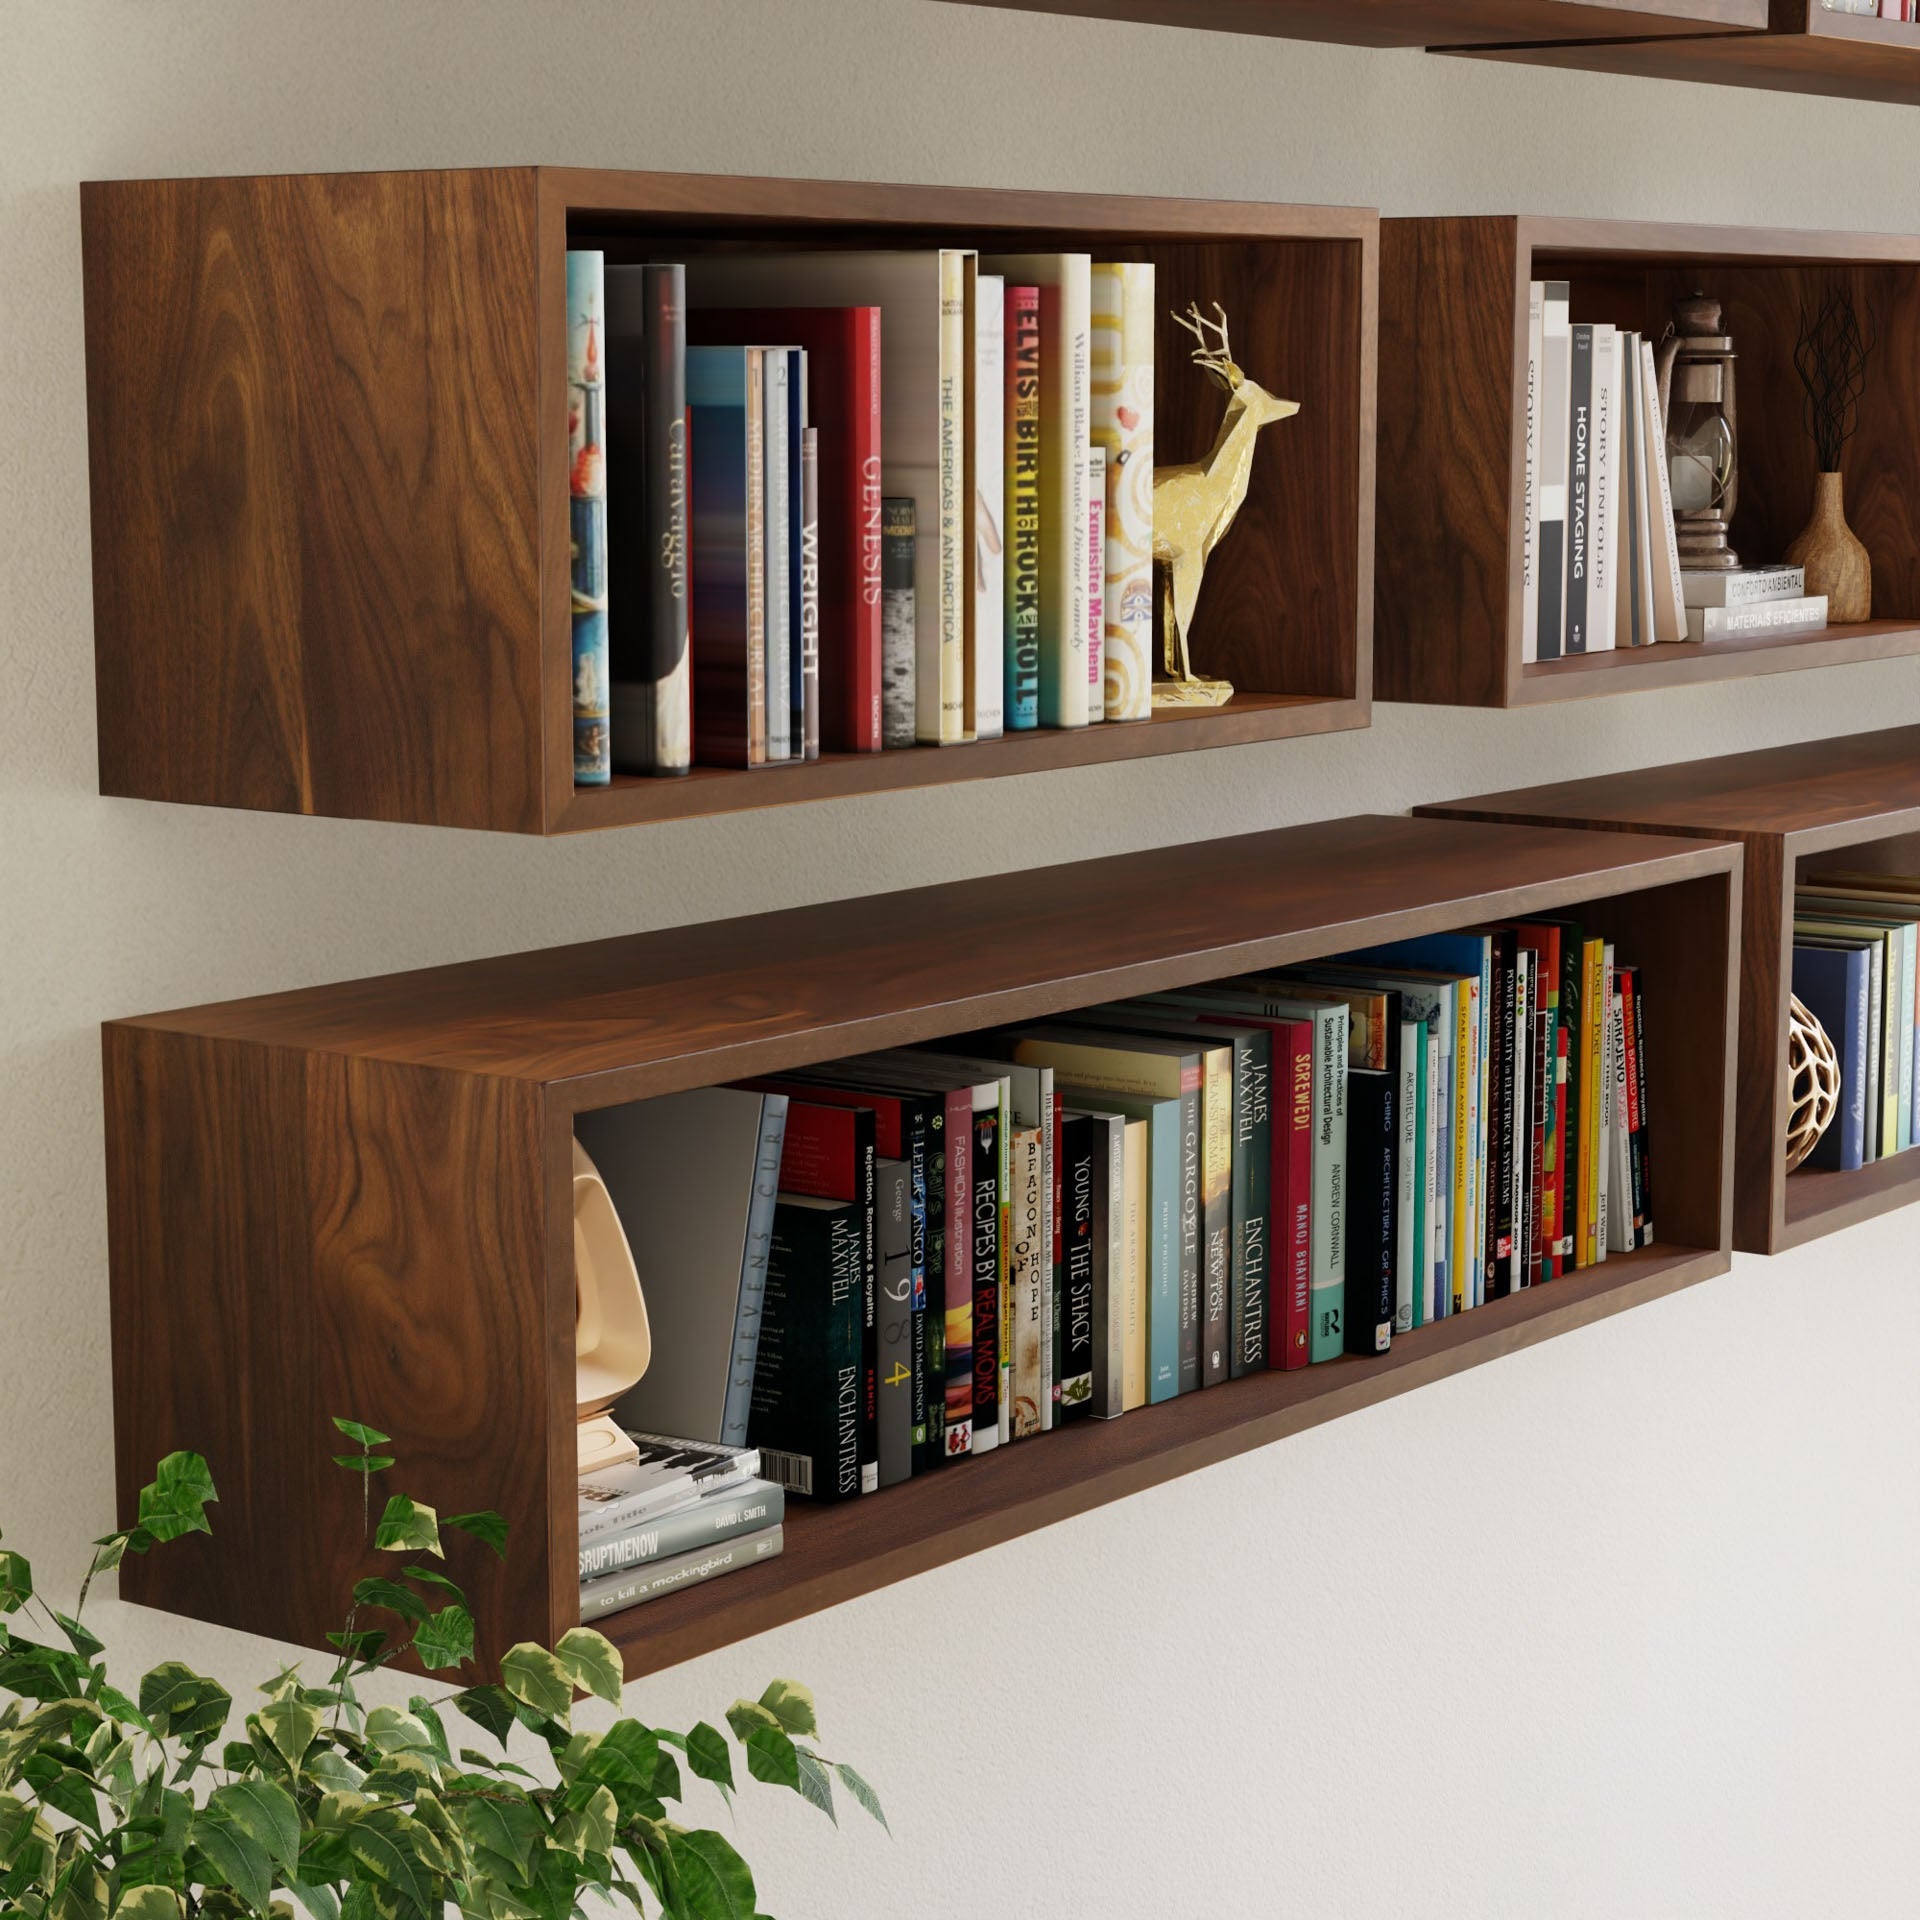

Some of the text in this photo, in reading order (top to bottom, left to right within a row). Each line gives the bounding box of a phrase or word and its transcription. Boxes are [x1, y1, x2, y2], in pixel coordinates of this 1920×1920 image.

[776, 367, 786, 387] 2
[1015, 309, 1039, 399] ELVIS
[661, 419, 687, 599] Caravaggio
[941, 376, 955, 644] THE AMERICAS & ANTARCTICA
[1016, 420, 1039, 515] BIRTH
[1070, 333, 1085, 653] William Blake: Dante's Divine Comedy
[1574, 407, 1587, 580] HOME STAGING
[1596, 387, 1608, 589] STORY UNFOLDS
[862, 455, 882, 605] GENESIS
[1018, 517, 1038, 529] OF
[749, 519, 764, 673] ARCHITECTURE
[803, 520, 819, 680] WRIGHT
[1016, 530, 1039, 615] ROCK
[1768, 573, 1802, 592] AMBIENTAL
[1016, 627, 1038, 705] ROLL
[1334, 1015, 1345, 1117] Principles and Practices of
[1459, 1005, 1467, 1041] SPARK
[1459, 1045, 1467, 1089] DESIGN
[1624, 993, 1636, 1047] BEHIND
[1870, 1010, 1881, 1086] Literature
[1187, 1098, 1196, 1127] THE
[1239, 1048, 1253, 1148] MAXWELL
[1250, 1063, 1268, 1124] JAMES
[1320, 1017, 1335, 1145] Sustainable Architectural Design
[1404, 1071, 1415, 1144] ARCHITECTURE
[1502, 968, 1515, 1205] POWER QUALITY in ELECTRICAL SYSTEMS
[1613, 1007, 1628, 1130] SARAJEVO ROSES
[1627, 1048, 1638, 1095] BARBED
[1630, 1098, 1640, 1129] WIRE
[914, 1112, 924, 1124] 95
[864, 1145, 875, 1328] Rejection, Romance & Royalties
[894, 1178, 907, 1223] George
[912, 1141, 926, 1265] LEPER TANGO
[953, 1135, 967, 1276] FASHION illustration
[1182, 1131, 1198, 1257] GARGOYLE
[1330, 1163, 1341, 1270] ANDREW CORNWALL
[1380, 1090, 1392, 1315] CHING ARCHITECTURAL GRAPHICS
[1513, 1172, 1521, 1224] YEARBOOK
[1599, 1192, 1607, 1247] Jeff Watts
[735, 1233, 772, 1388] STEVENS
[757, 1111, 785, 1199] CURL
[831, 1219, 849, 1306] MAXWELL
[849, 1231, 862, 1284] JAMES
[975, 1178, 997, 1405] RECIPES BY REAL MOMS
[1028, 1252, 1040, 1322] HOPE
[1070, 1156, 1092, 1352] YOUNG THE SHACK
[1209, 1231, 1219, 1322] NEWTON
[1243, 1216, 1264, 1364] ENCHANTRESS
[1294, 1203, 1308, 1313] MANOJ BHAVNANI
[1182, 1269, 1191, 1330] DAVIDSON
[914, 1313, 926, 1421] DAVID MacKINNON
[838, 1365, 858, 1495] ENCHANTRESS
[715, 1505, 767, 1530] DAVID SMITH
[600, 1552, 733, 1607] to kill a mockingbird
